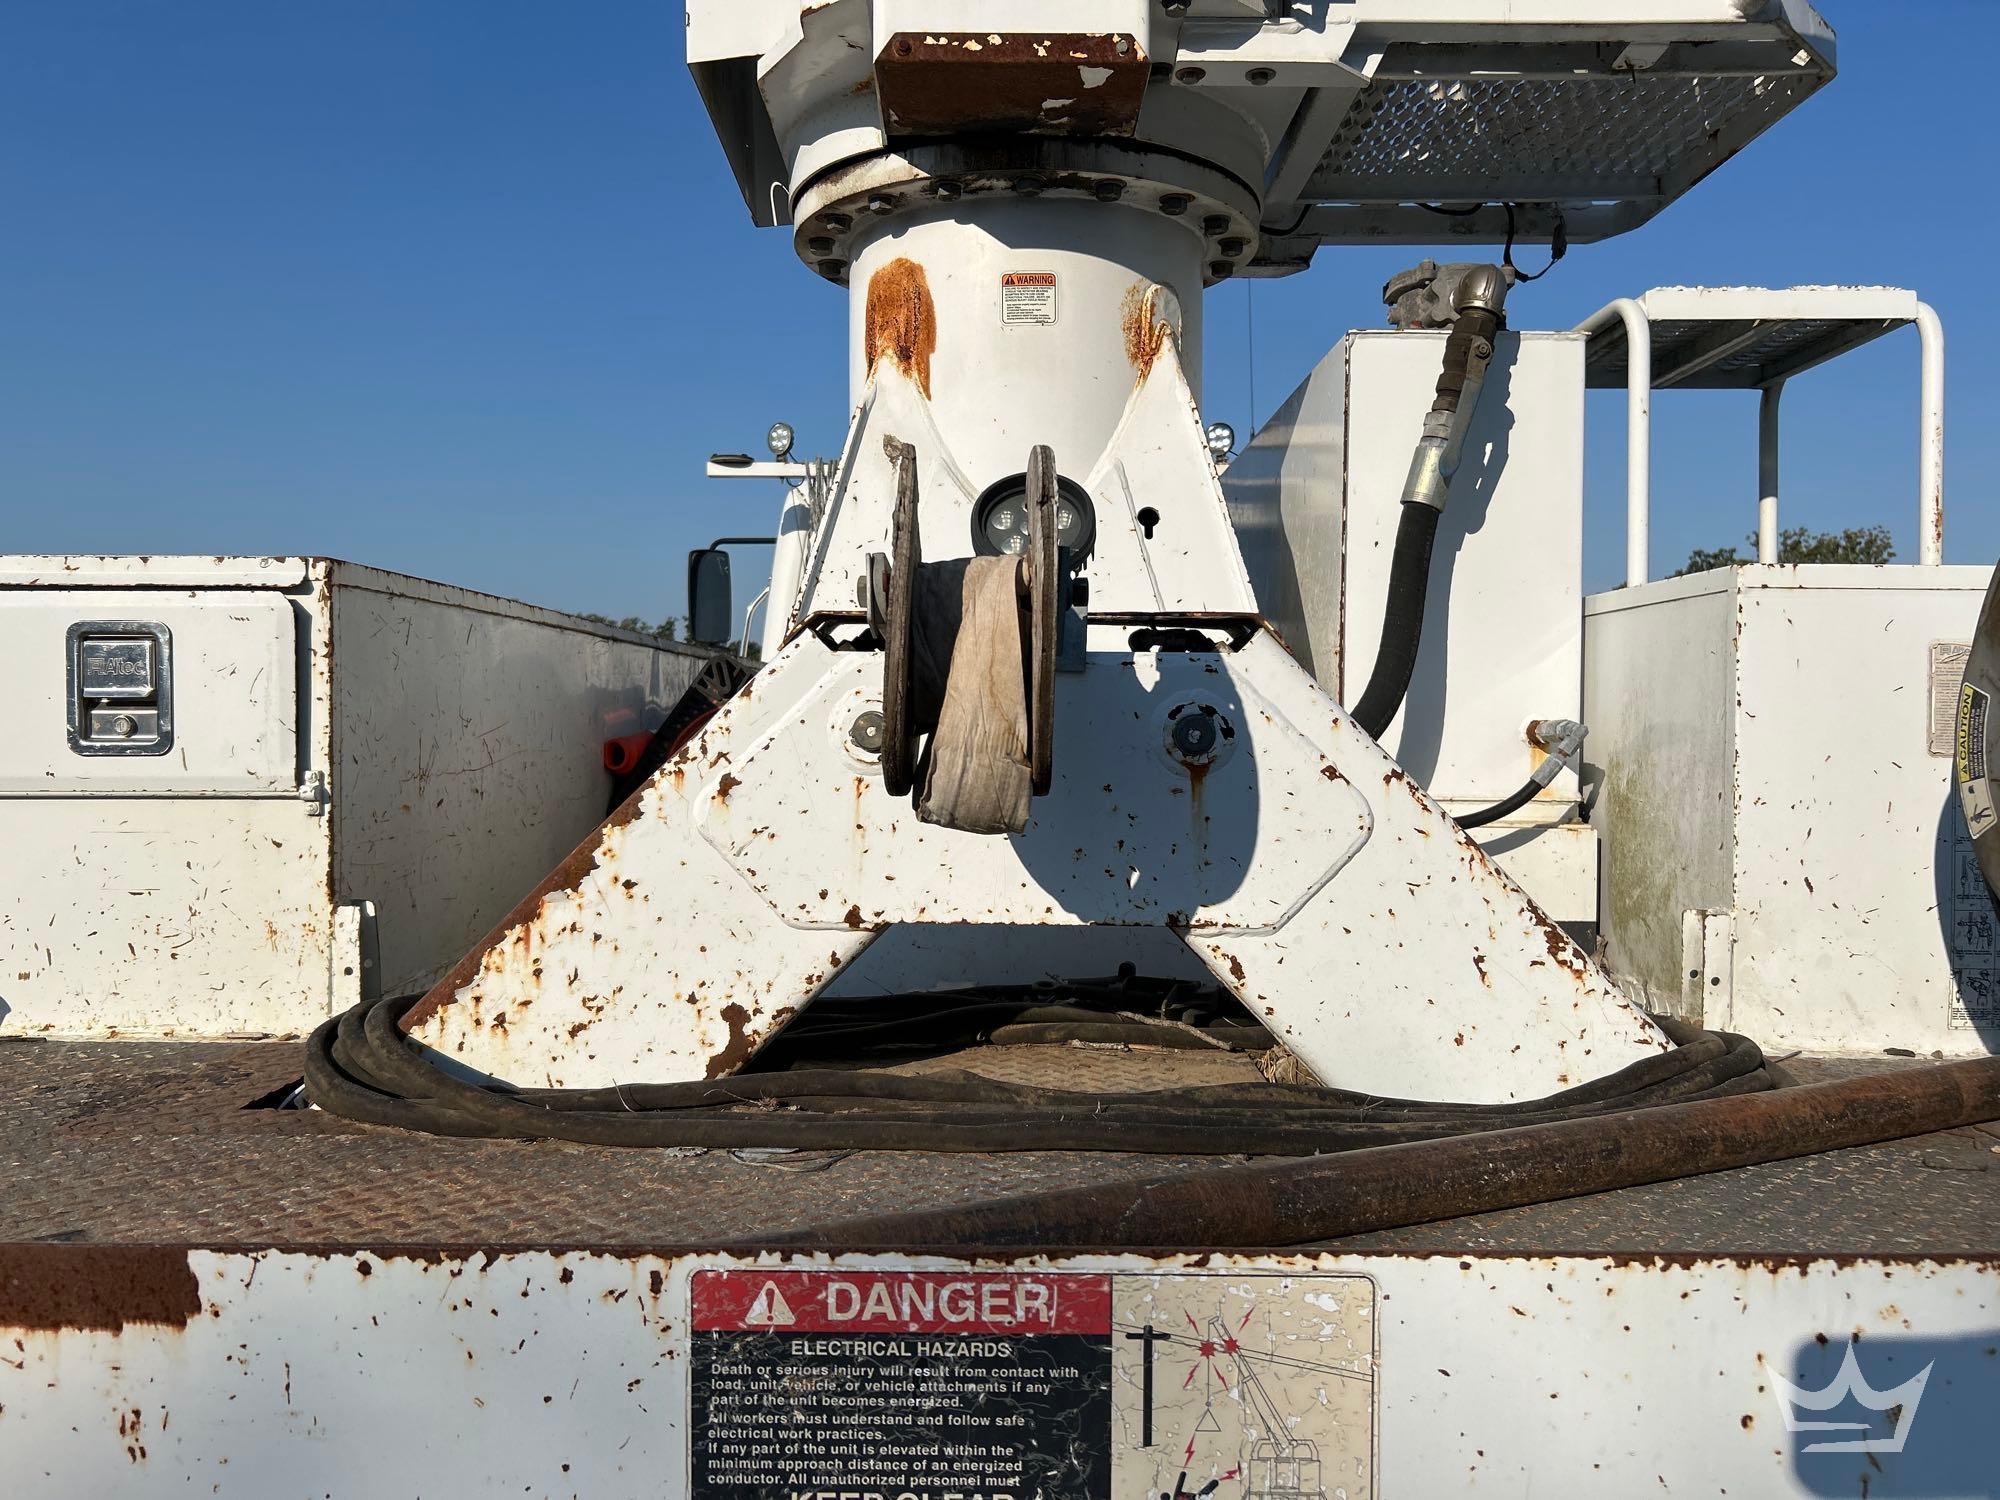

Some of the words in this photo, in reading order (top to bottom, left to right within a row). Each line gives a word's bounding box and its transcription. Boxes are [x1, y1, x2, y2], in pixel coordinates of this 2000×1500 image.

[1016, 275, 1053, 284] WARNING
[106, 657, 147, 676] Altec
[1960, 693, 1971, 761] CAUTION
[827, 1282, 1050, 1323] DANGER
[791, 1341, 911, 1357] ELECTRICAL
[917, 1342, 1011, 1358] HAZARDS
[711, 1364, 752, 1376] Death
[756, 1366, 771, 1376] or
[776, 1365, 828, 1376] serious
[834, 1365, 874, 1379] injury
[880, 1366, 904, 1376] will
[909, 1366, 950, 1377] result
[954, 1366, 986, 1378] from
[991, 1367, 1045, 1378] contact
[1049, 1367, 1079, 1378] with
[711, 1379, 746, 1392] load,
[845, 1383, 860, 1392] or
[864, 1380, 915, 1392] vehicle
[920, 1381, 1007, 1393] attachments
[1012, 1382, 1022, 1393] if
[1026, 1384, 1051, 1396] any
[711, 1395, 740, 1409] part
[744, 1395, 759, 1406] of
[762, 1395, 784, 1406] the
[790, 1395, 818, 1406] unit
[822, 1396, 885, 1407] becomes
[890, 1396, 964, 1410] energized.
[708, 1413, 728, 1424] All
[732, 1414, 788, 1424] workers
[792, 1415, 828, 1425] must
[832, 1414, 912, 1426] understand
[917, 1414, 943, 1426] and
[948, 1414, 991, 1426] follow
[995, 1415, 1025, 1426] safe
[708, 1428, 774, 1440] electrical
[778, 1428, 812, 1440] work
[817, 1428, 887, 1443] practices.
[708, 1444, 719, 1454] If
[722, 1446, 746, 1458] any
[752, 1444, 780, 1458] part
[784, 1444, 800, 1454] of
[803, 1444, 826, 1454] the
[830, 1444, 859, 1455] unit
[862, 1444, 876, 1455] is
[879, 1444, 939, 1456] elevated
[943, 1445, 987, 1456] within
[991, 1445, 1014, 1456] the
[708, 1458, 773, 1470] minimum
[777, 1459, 843, 1472] approach
[848, 1459, 908, 1470] distance
[912, 1460, 927, 1470] of
[931, 1462, 949, 1470] an
[953, 1460, 1022, 1474] energized
[708, 1474, 784, 1484] conductor.
[788, 1474, 807, 1485] All
[812, 1474, 905, 1486] unauthorized
[910, 1475, 980, 1488] personnel
[986, 1476, 1021, 1486] must
